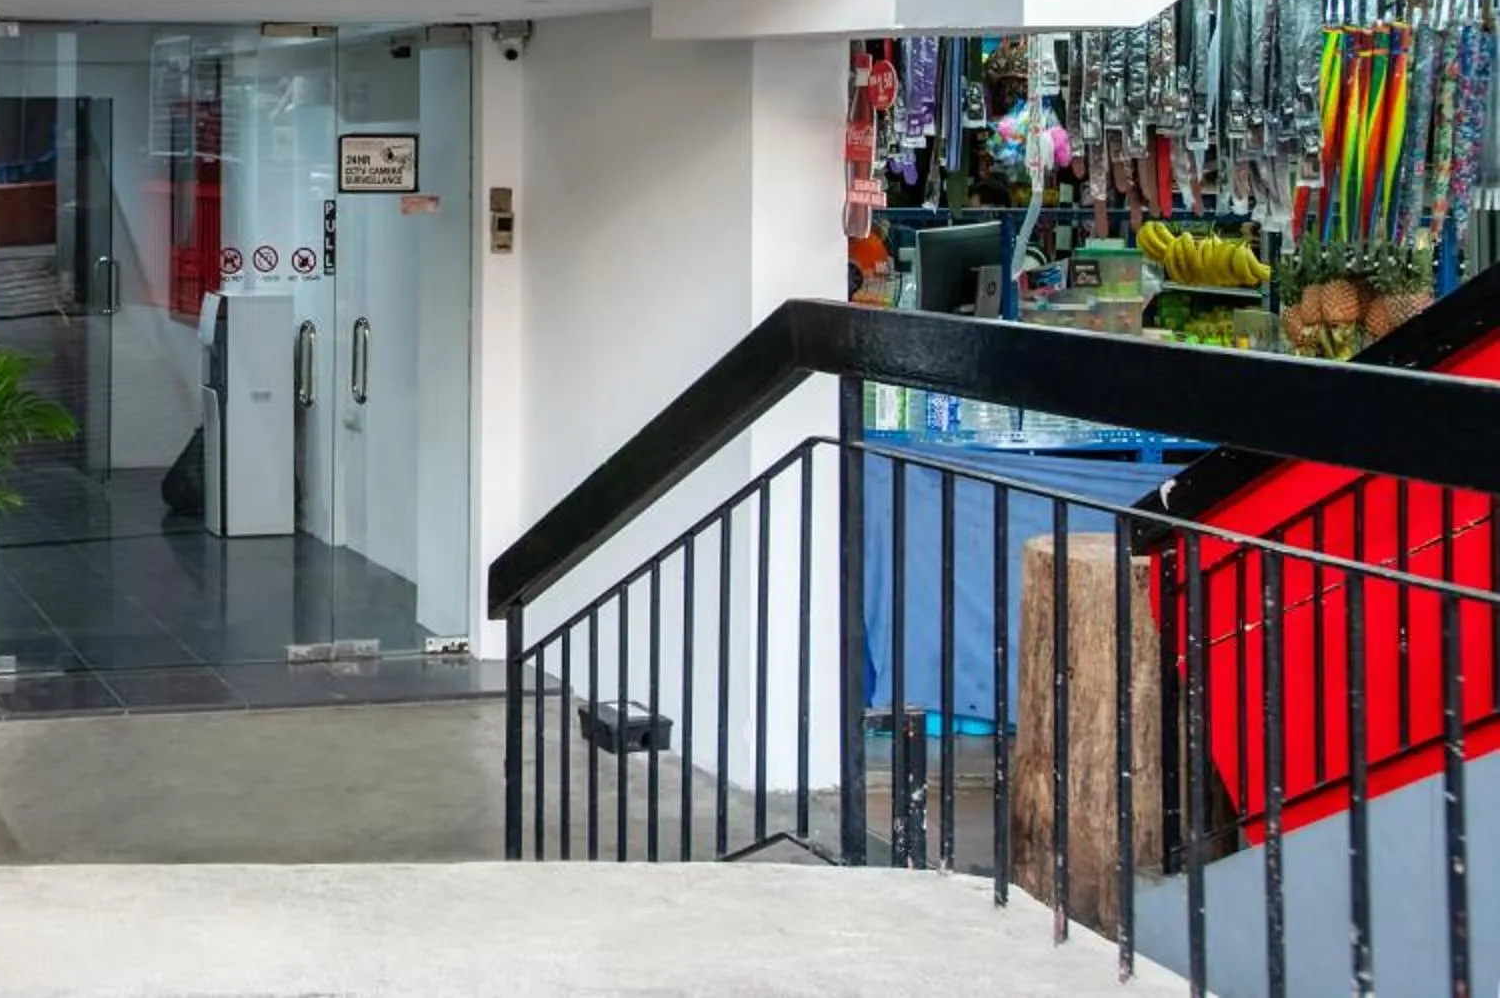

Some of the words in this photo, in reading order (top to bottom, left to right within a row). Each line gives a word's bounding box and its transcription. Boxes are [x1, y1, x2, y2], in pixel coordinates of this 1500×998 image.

[368, 167, 402, 175] CAMERA
[345, 175, 402, 184] SURVEILLANCE
[325, 201, 336, 267] PULL
